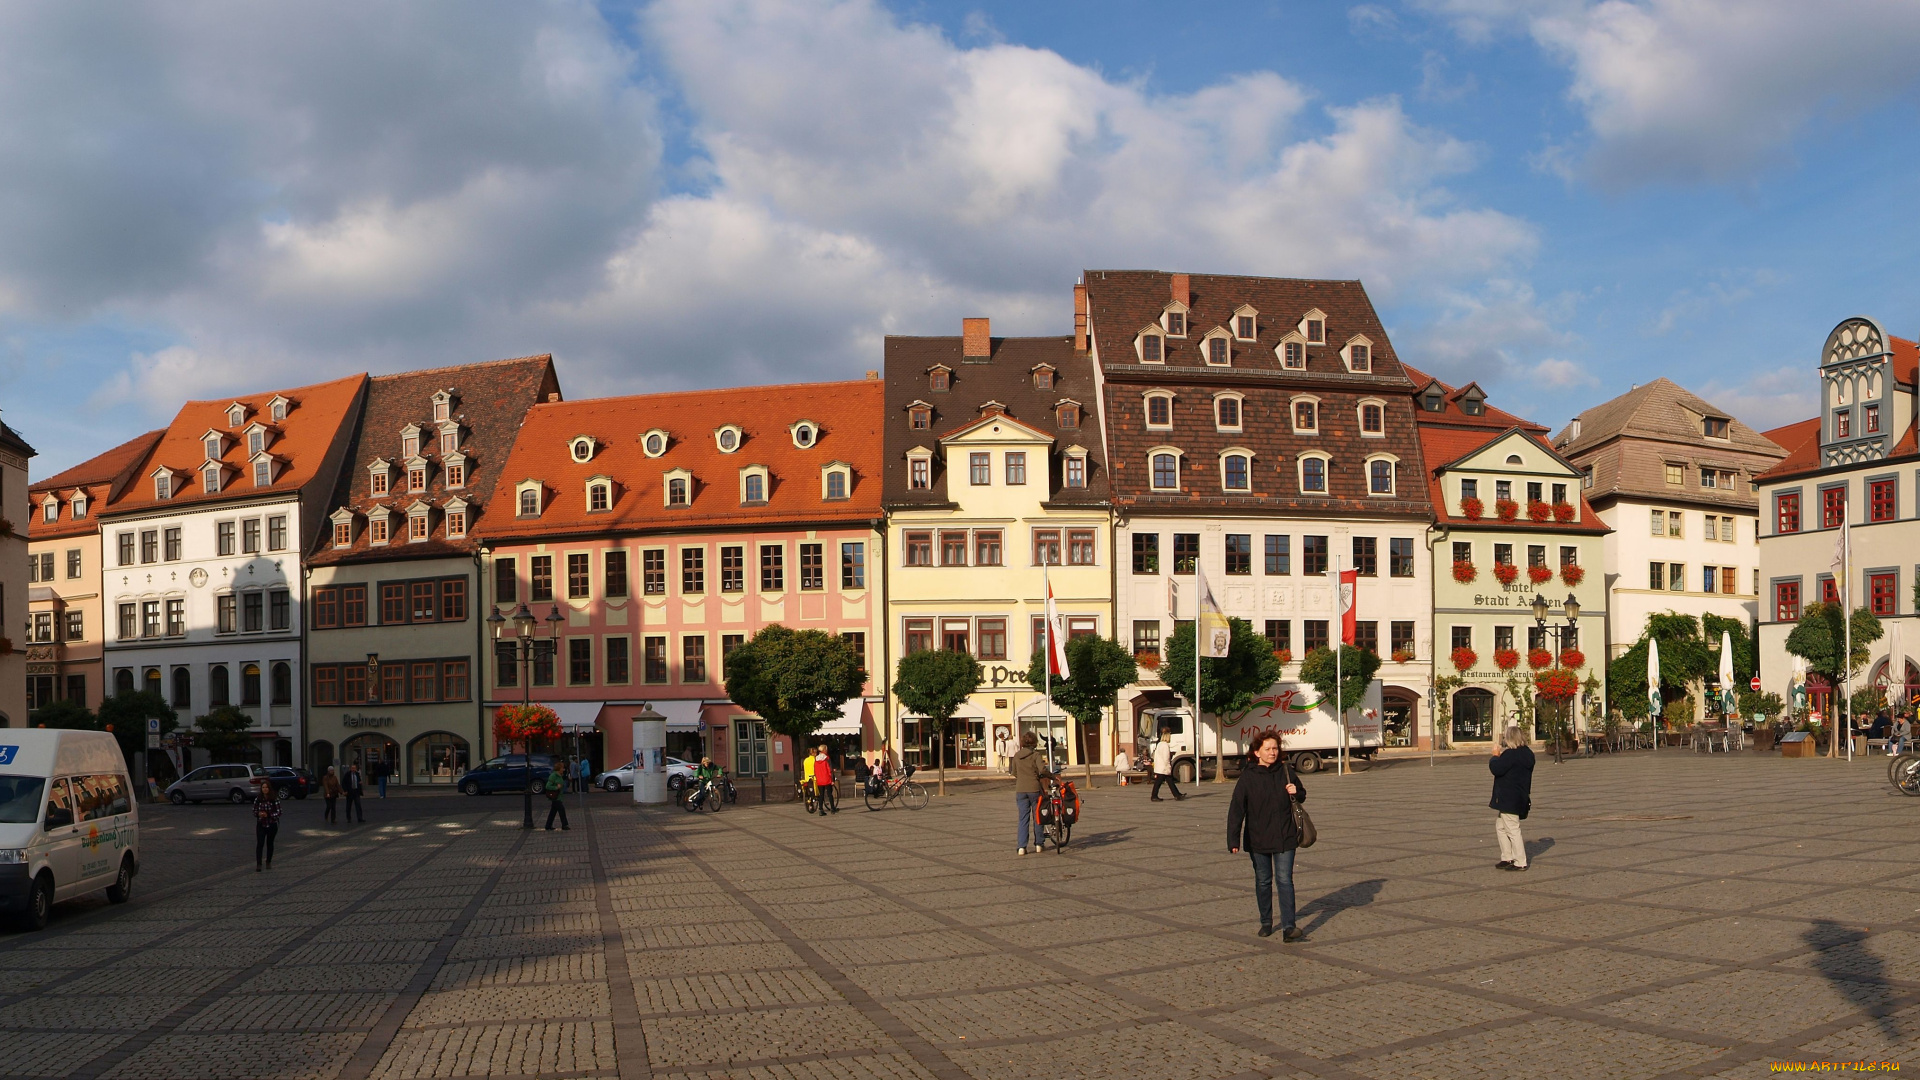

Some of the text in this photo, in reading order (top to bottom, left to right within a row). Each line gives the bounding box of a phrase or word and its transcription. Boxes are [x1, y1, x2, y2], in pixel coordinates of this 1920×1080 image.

[1502, 581, 1534, 594] Hotel
[1474, 594, 1562, 608] Stadt Aaen
[990, 665, 1028, 688] Pre
[1461, 670, 1534, 678] Restaurant Carolu
[1240, 725, 1261, 741] MD
